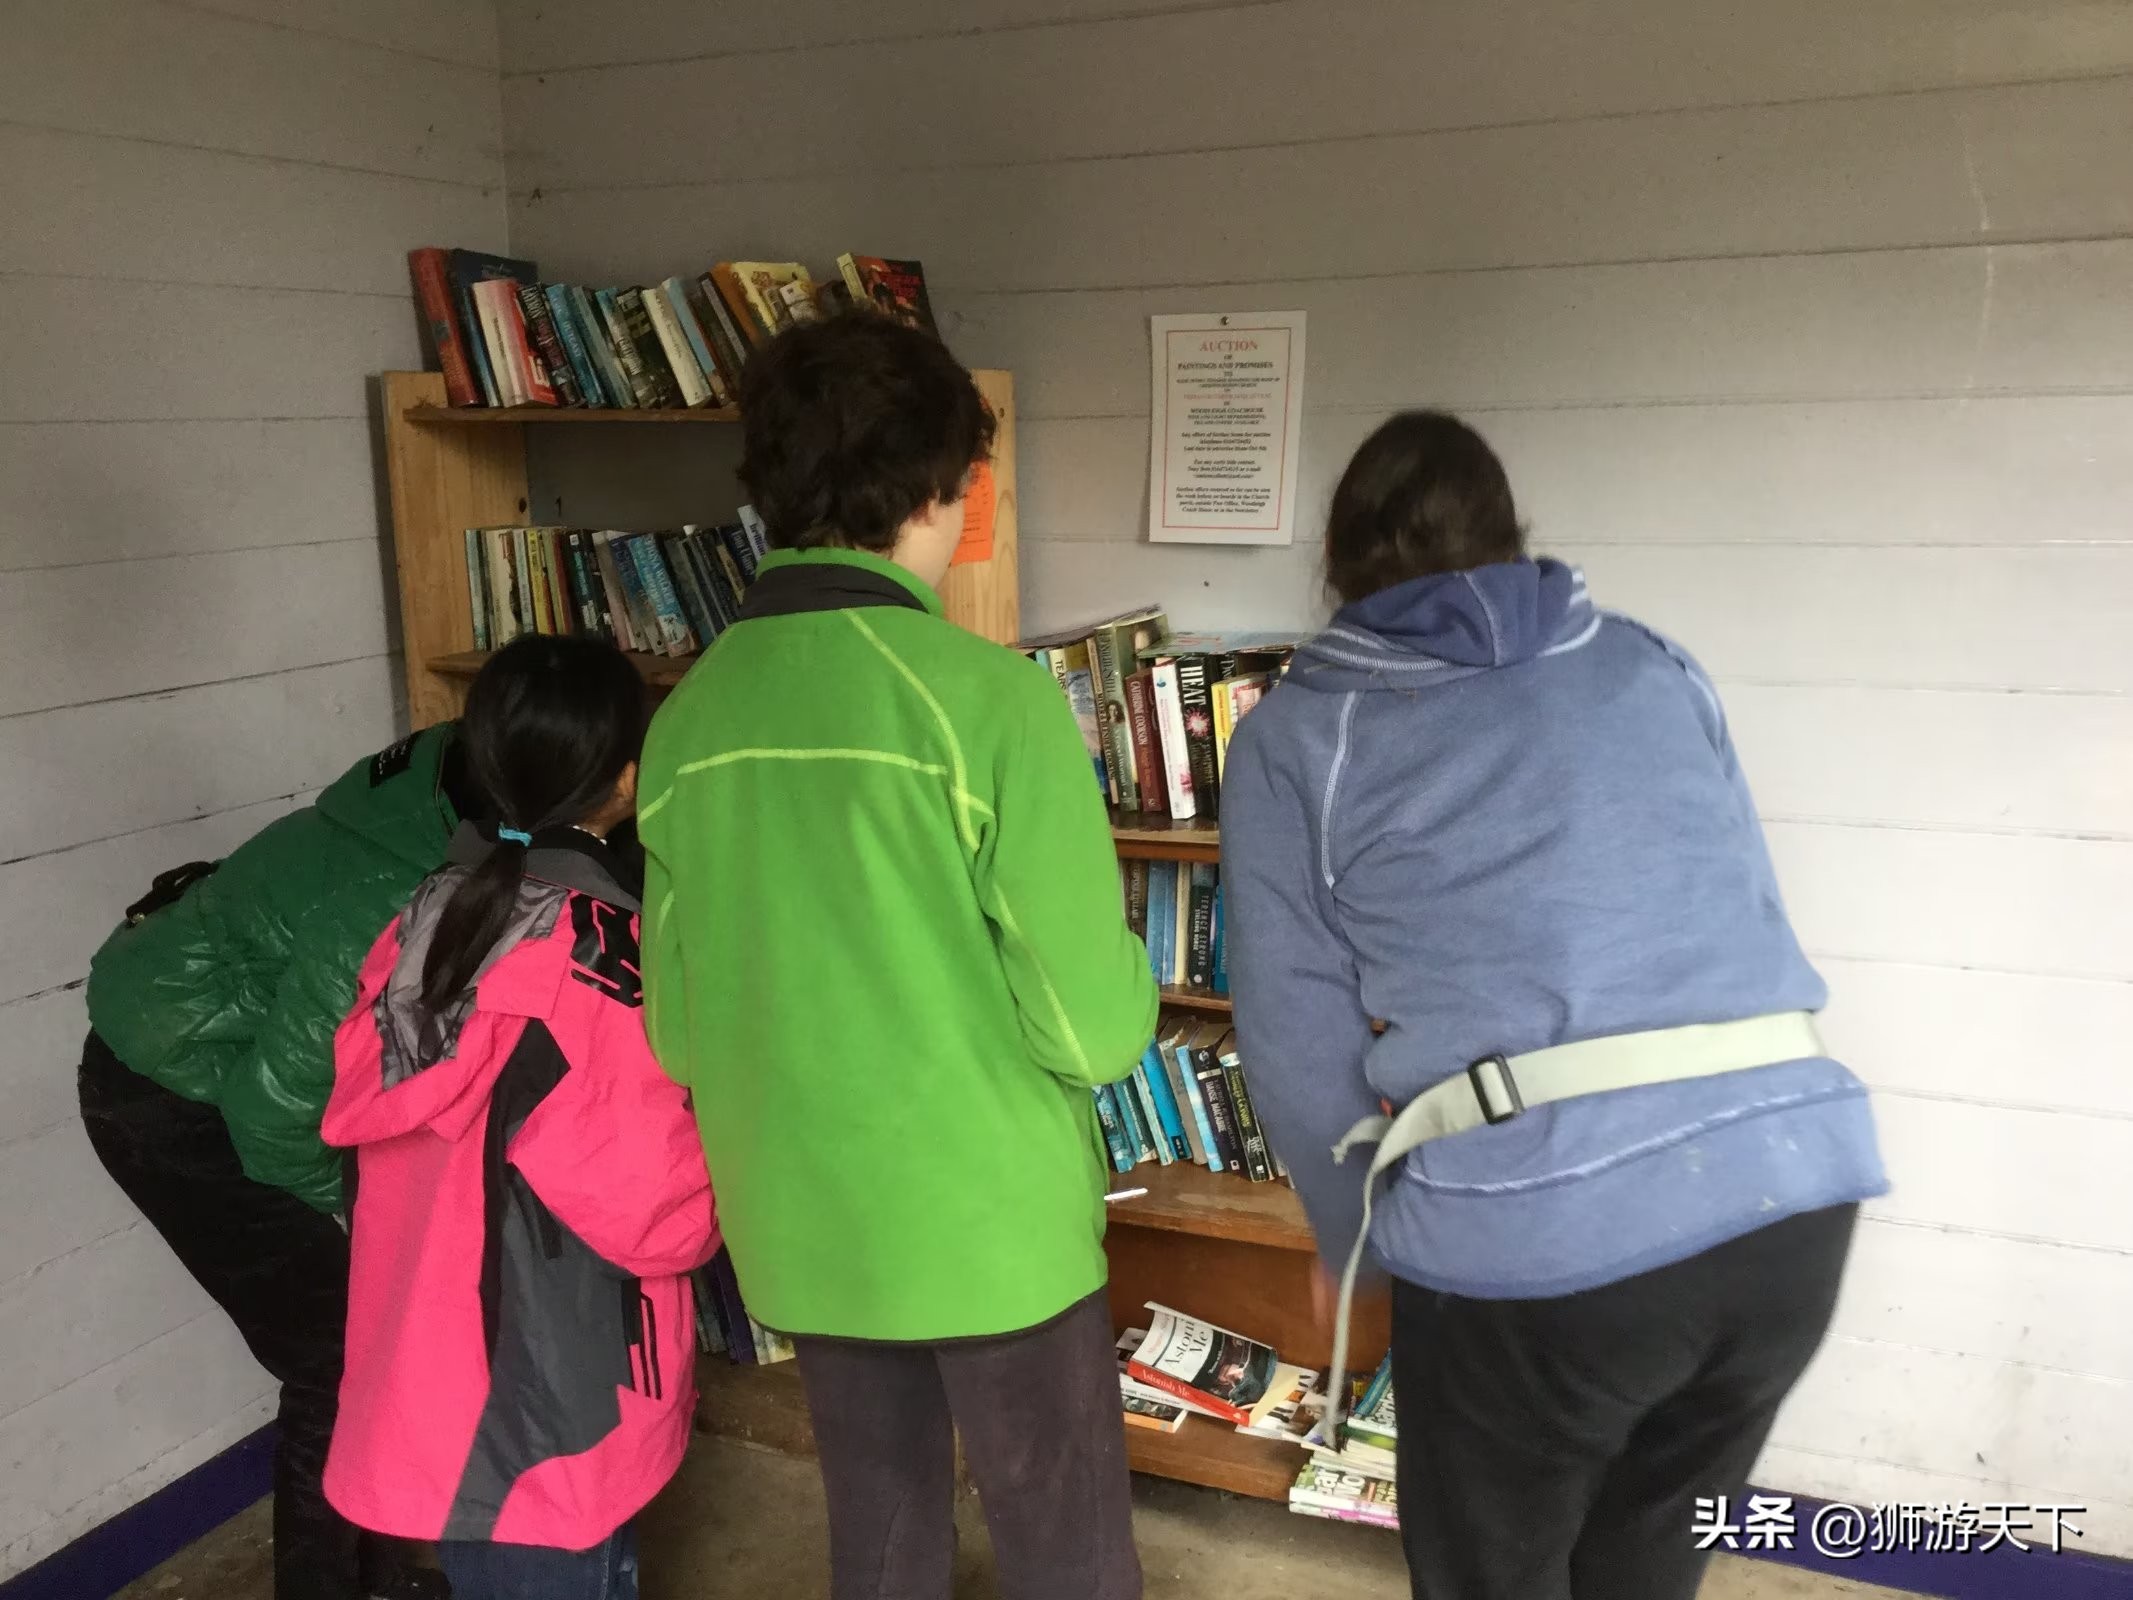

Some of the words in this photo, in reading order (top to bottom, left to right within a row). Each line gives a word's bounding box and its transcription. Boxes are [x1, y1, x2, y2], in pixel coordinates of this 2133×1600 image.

[1199, 339, 1258, 352] AUCTION
[1130, 680, 1146, 715] CATHERINE
[1180, 665, 1207, 706] HEAT
[1134, 714, 1149, 745] COOKSON
[1201, 895, 1210, 931] TERENCE
[1197, 934, 1207, 966] STRONG
[1205, 1081, 1217, 1103] DANSE
[1211, 1102, 1227, 1133] MACABRE
[1165, 1318, 1196, 1366] Astoni
[1189, 1331, 1209, 1354] Me
[1141, 1369, 1176, 1392] Astonish
[1177, 1384, 1191, 1398] Me
